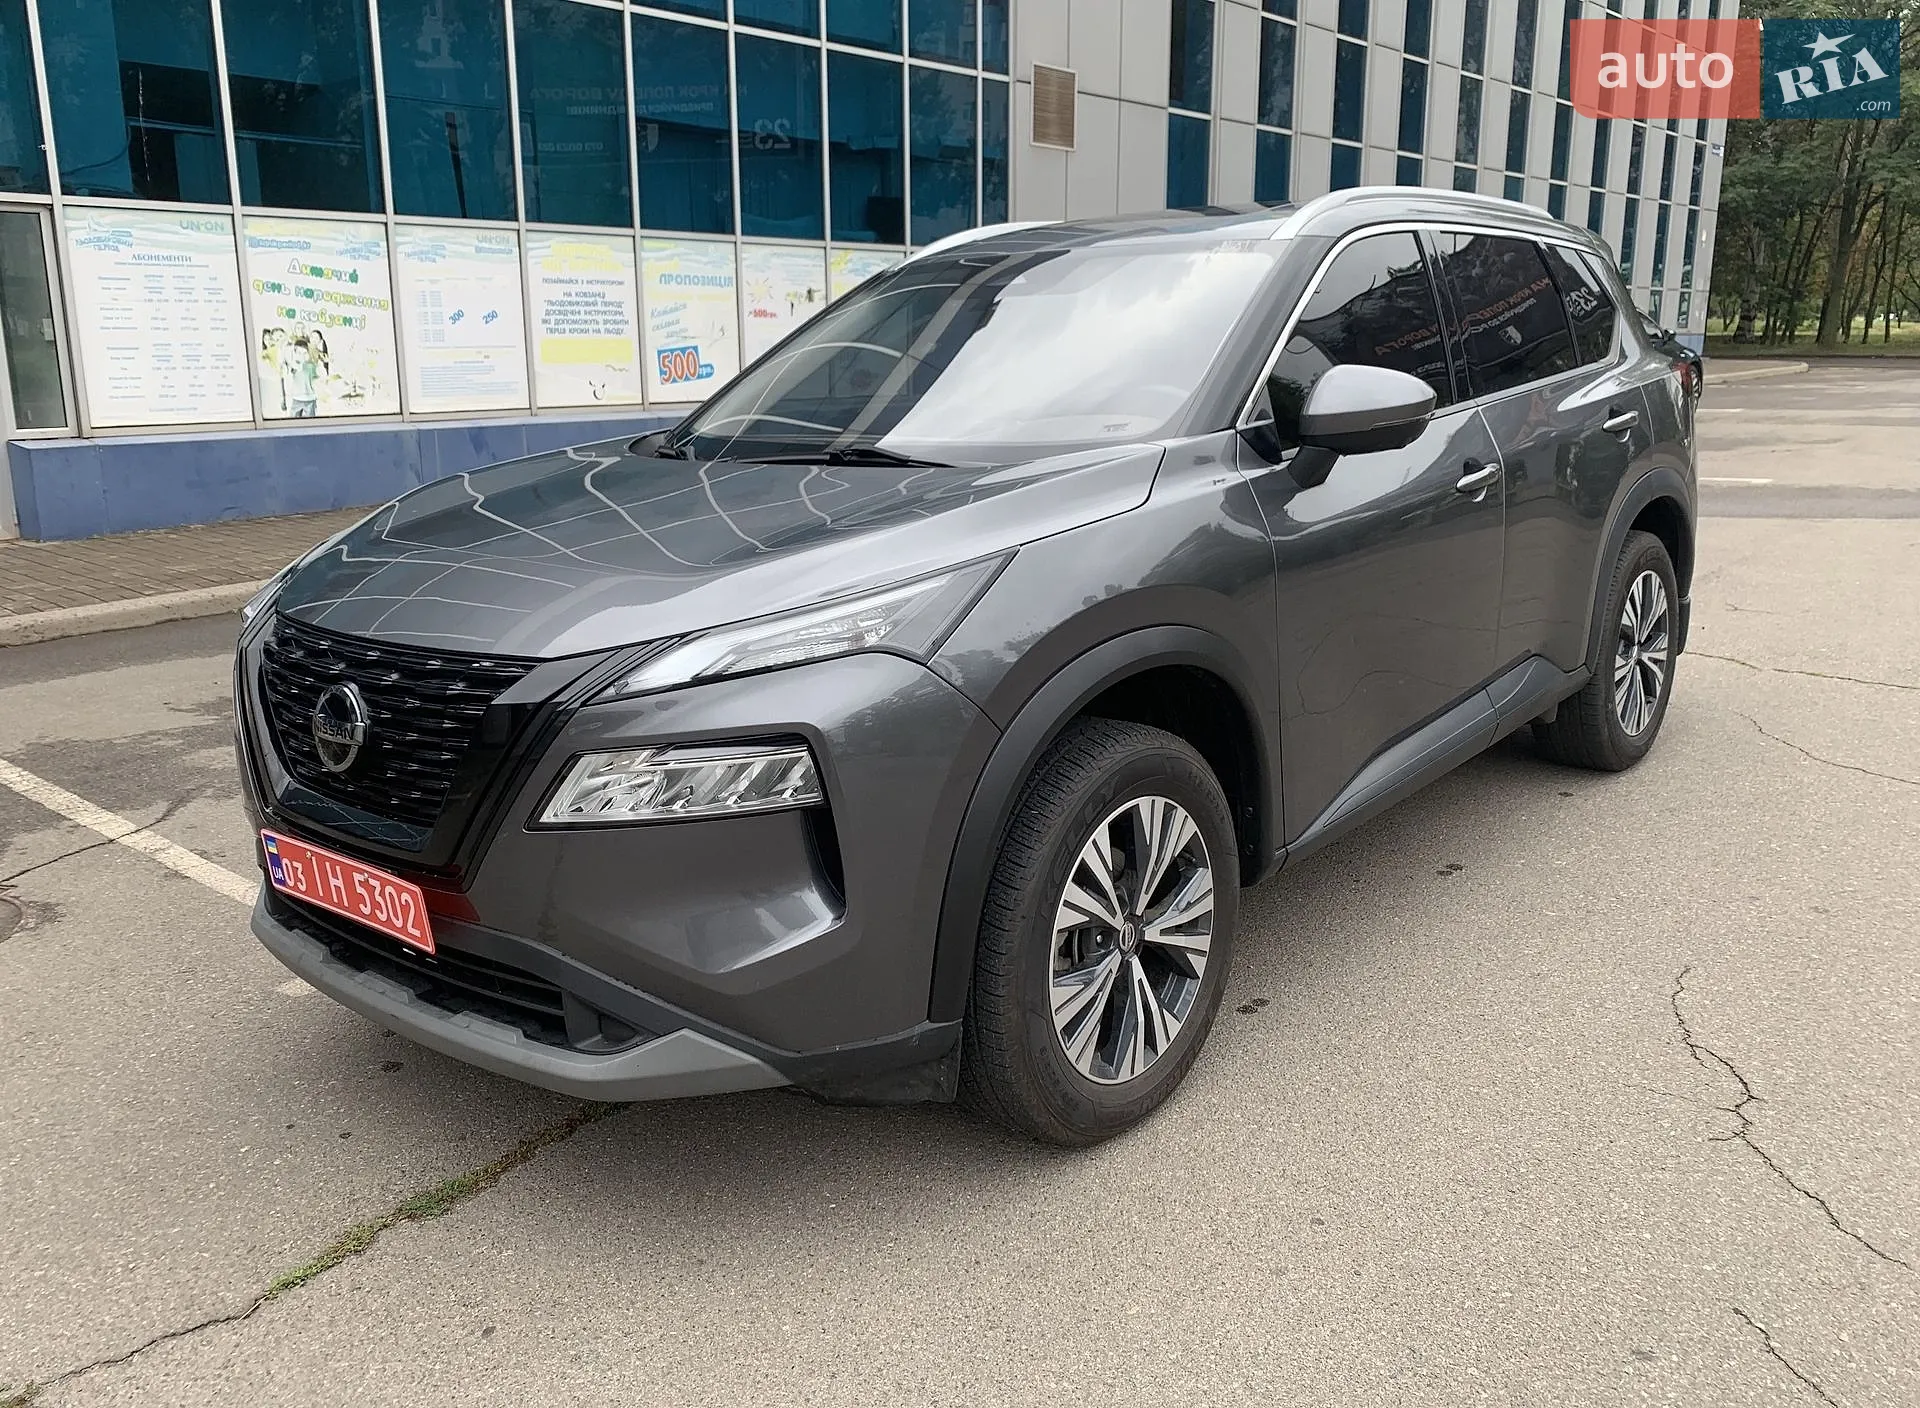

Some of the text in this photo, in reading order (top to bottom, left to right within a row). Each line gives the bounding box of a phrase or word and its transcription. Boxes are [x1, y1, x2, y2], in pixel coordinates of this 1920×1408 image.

[131, 253, 192, 263] АБОНЕМЕНТИ
[659, 273, 733, 287] ПРОПОЗИЦІЯ
[449, 309, 464, 324] 300
[482, 310, 498, 324] 250
[661, 350, 698, 383] 500
[272, 865, 285, 882] UA
[282, 857, 307, 892] 03
[353, 871, 421, 937] 5302
